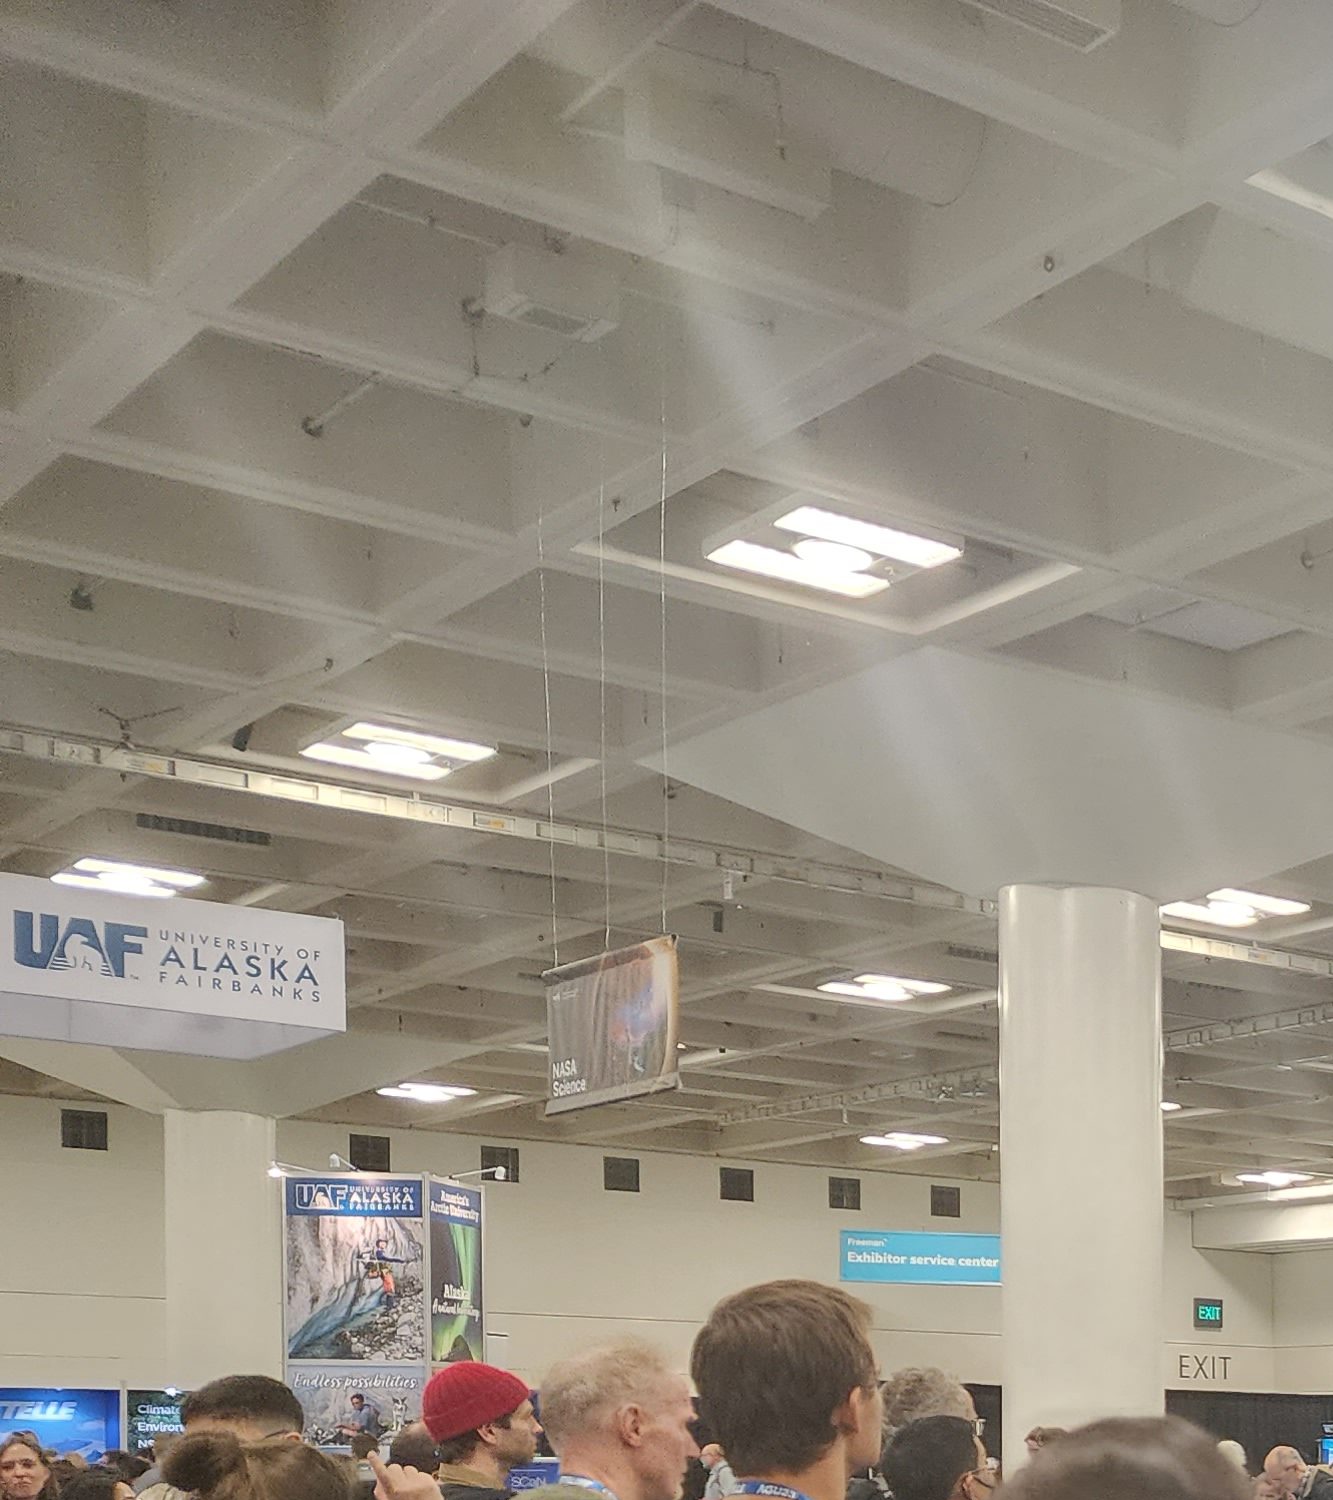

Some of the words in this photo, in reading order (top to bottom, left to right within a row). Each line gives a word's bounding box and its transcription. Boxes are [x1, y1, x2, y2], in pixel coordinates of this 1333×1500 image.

[13, 909, 148, 979] UAF
[160, 930, 284, 955] UNIVERSITY
[297, 949, 321, 961] OF
[160, 946, 319, 986] ALASKA
[159, 972, 320, 1002] FAIRBANKS
[552, 1058, 577, 1080] NASA
[553, 1079, 586, 1097] Science
[296, 1184, 348, 1210] UAF
[350, 1192, 414, 1204] ALASKA
[848, 1251, 907, 1265] Exhibitor
[910, 1254, 955, 1266] service
[958, 1256, 999, 1267] center
[1199, 1306, 1221, 1320] EXIT
[1179, 1354, 1232, 1380] EXIT
[294, 1373, 342, 1389] Endless
